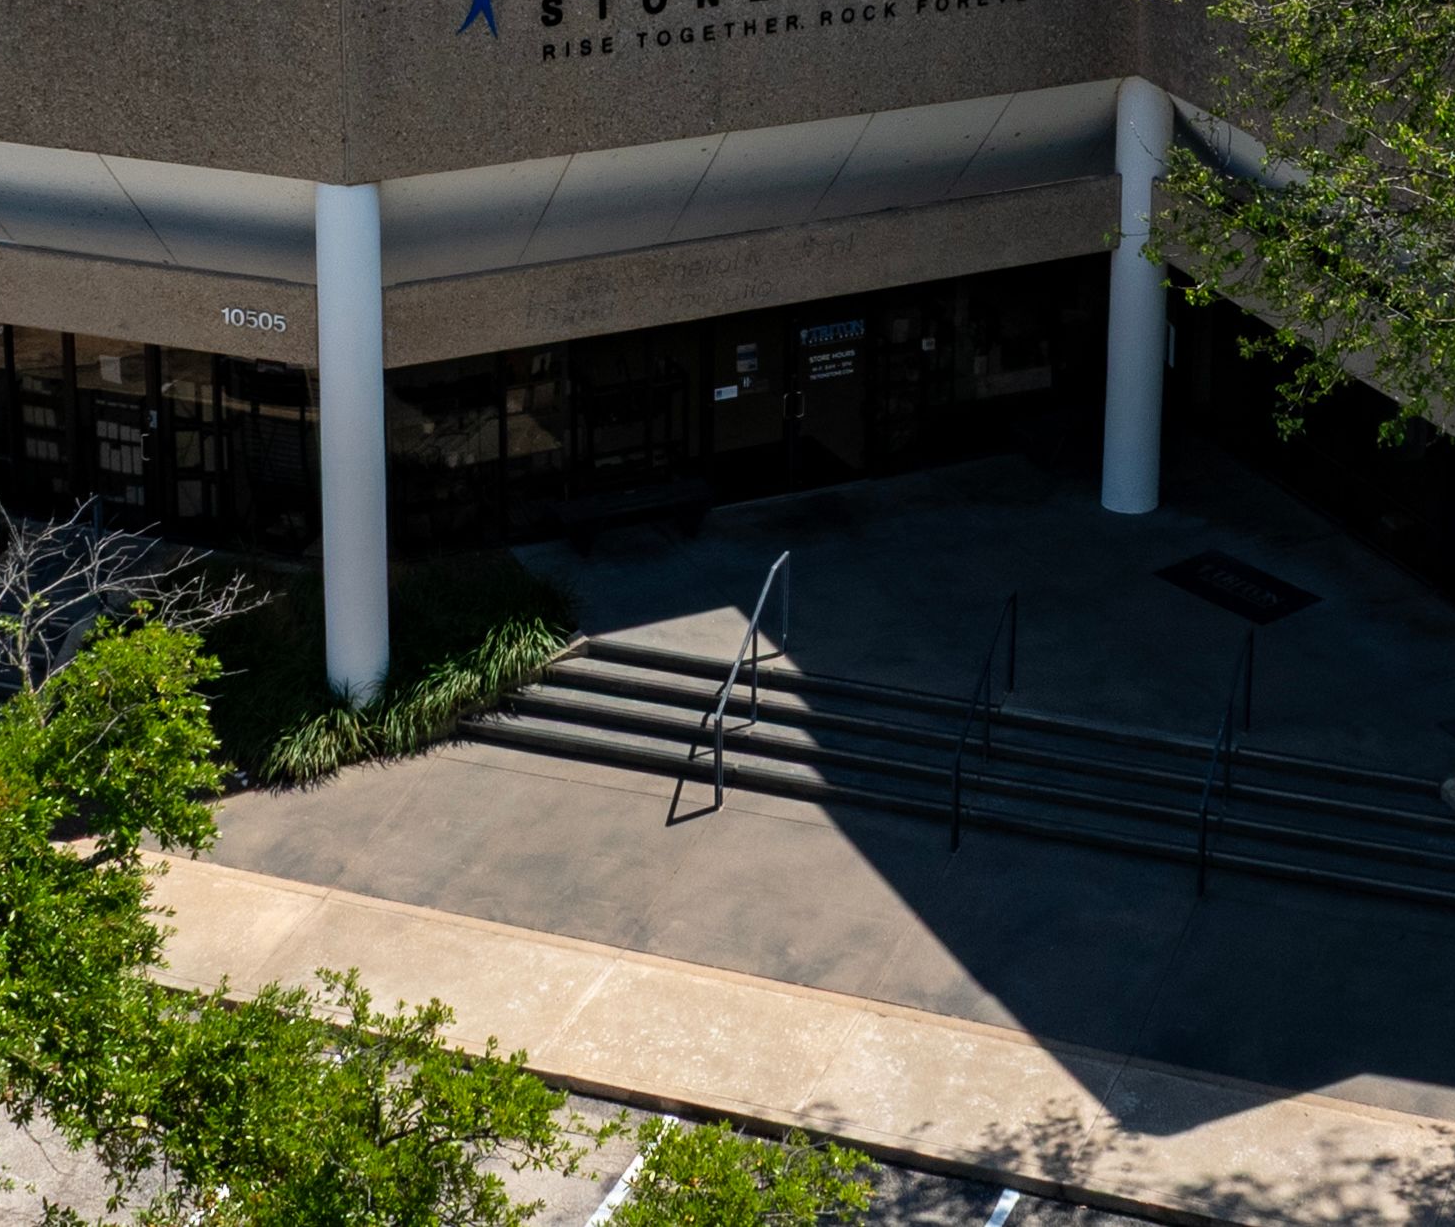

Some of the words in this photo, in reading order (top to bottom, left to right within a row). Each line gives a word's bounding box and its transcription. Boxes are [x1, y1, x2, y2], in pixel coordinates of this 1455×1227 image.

[542, 37, 614, 61] RISE
[636, 14, 805, 49] TOGETHER.
[819, 2, 896, 26] ROCK
[220, 307, 287, 333] 10505
